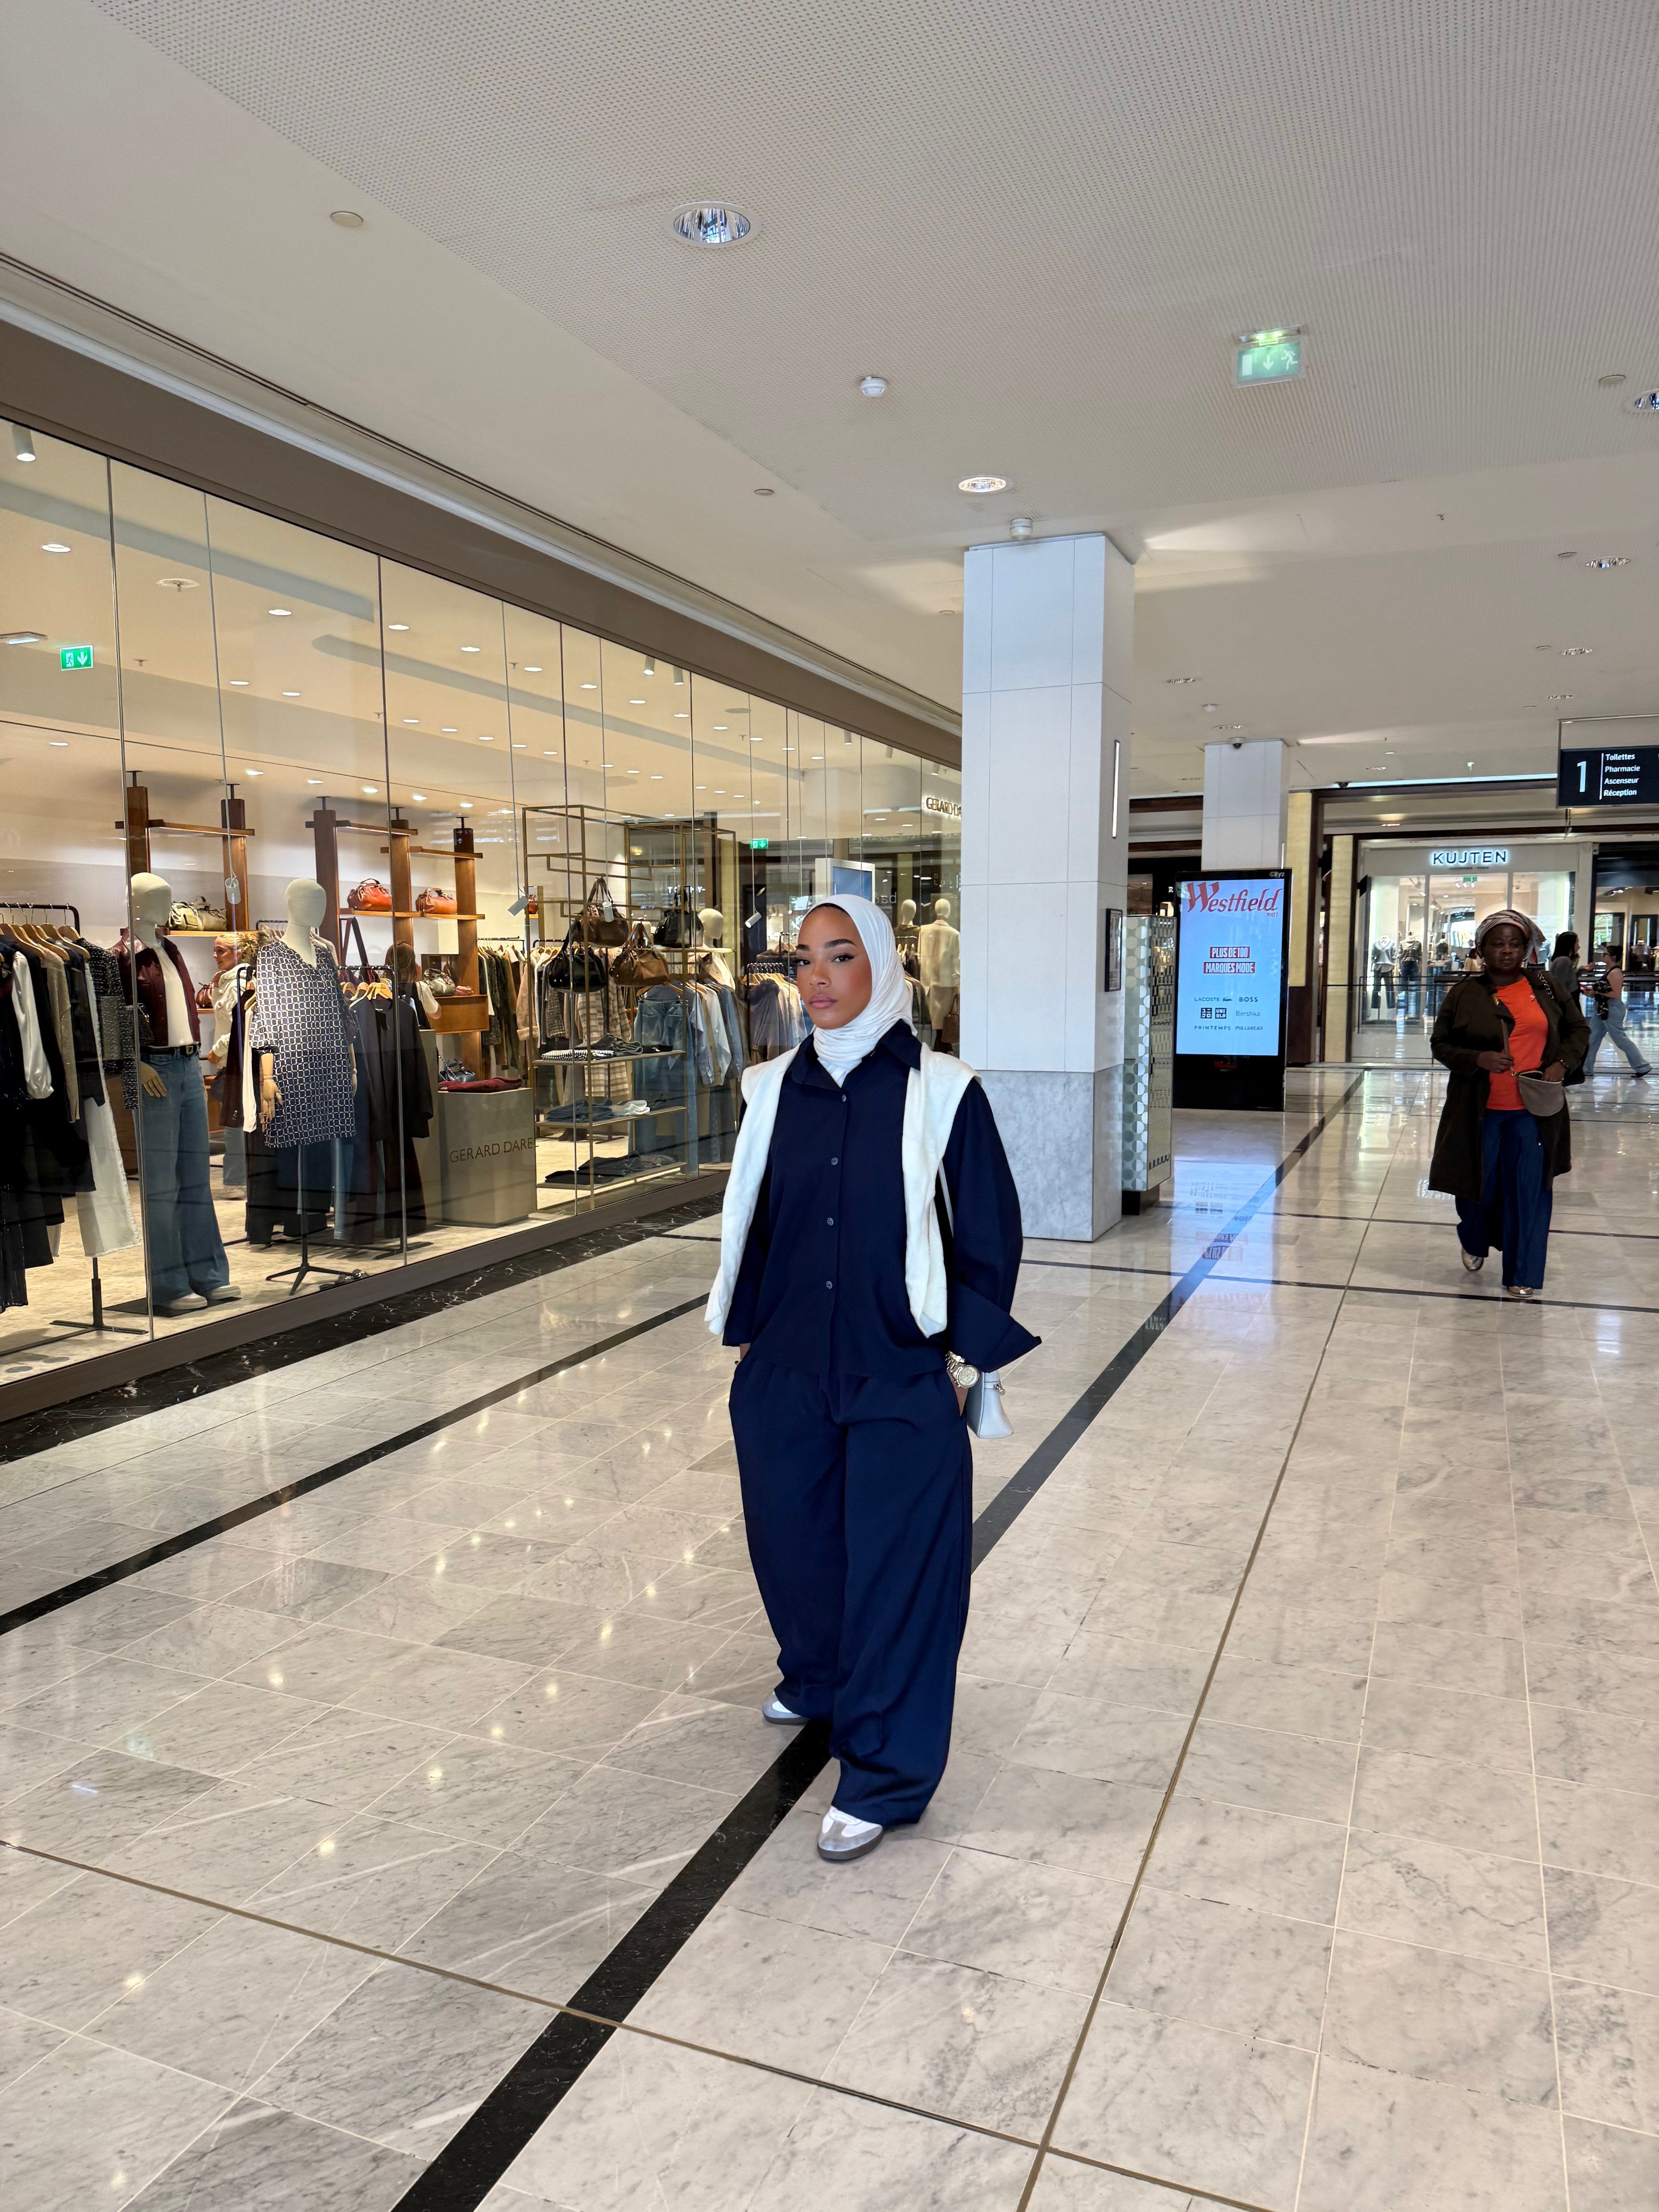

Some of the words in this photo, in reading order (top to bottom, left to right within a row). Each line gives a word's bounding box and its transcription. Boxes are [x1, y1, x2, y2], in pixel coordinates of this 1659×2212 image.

[1577, 761, 1586, 792] 1
[1603, 789, 1637, 797] Réception
[1433, 851, 1506, 864] KUJTEN
[1186, 881, 1283, 913] Westfield
[1211, 947, 1227, 958] PLUS
[1228, 947, 1236, 958] DE
[1237, 947, 1248, 957] 100
[1205, 963, 1235, 973] MARQUES
[1236, 963, 1254, 973] MODE
[449, 1143, 500, 1162] GERARD
